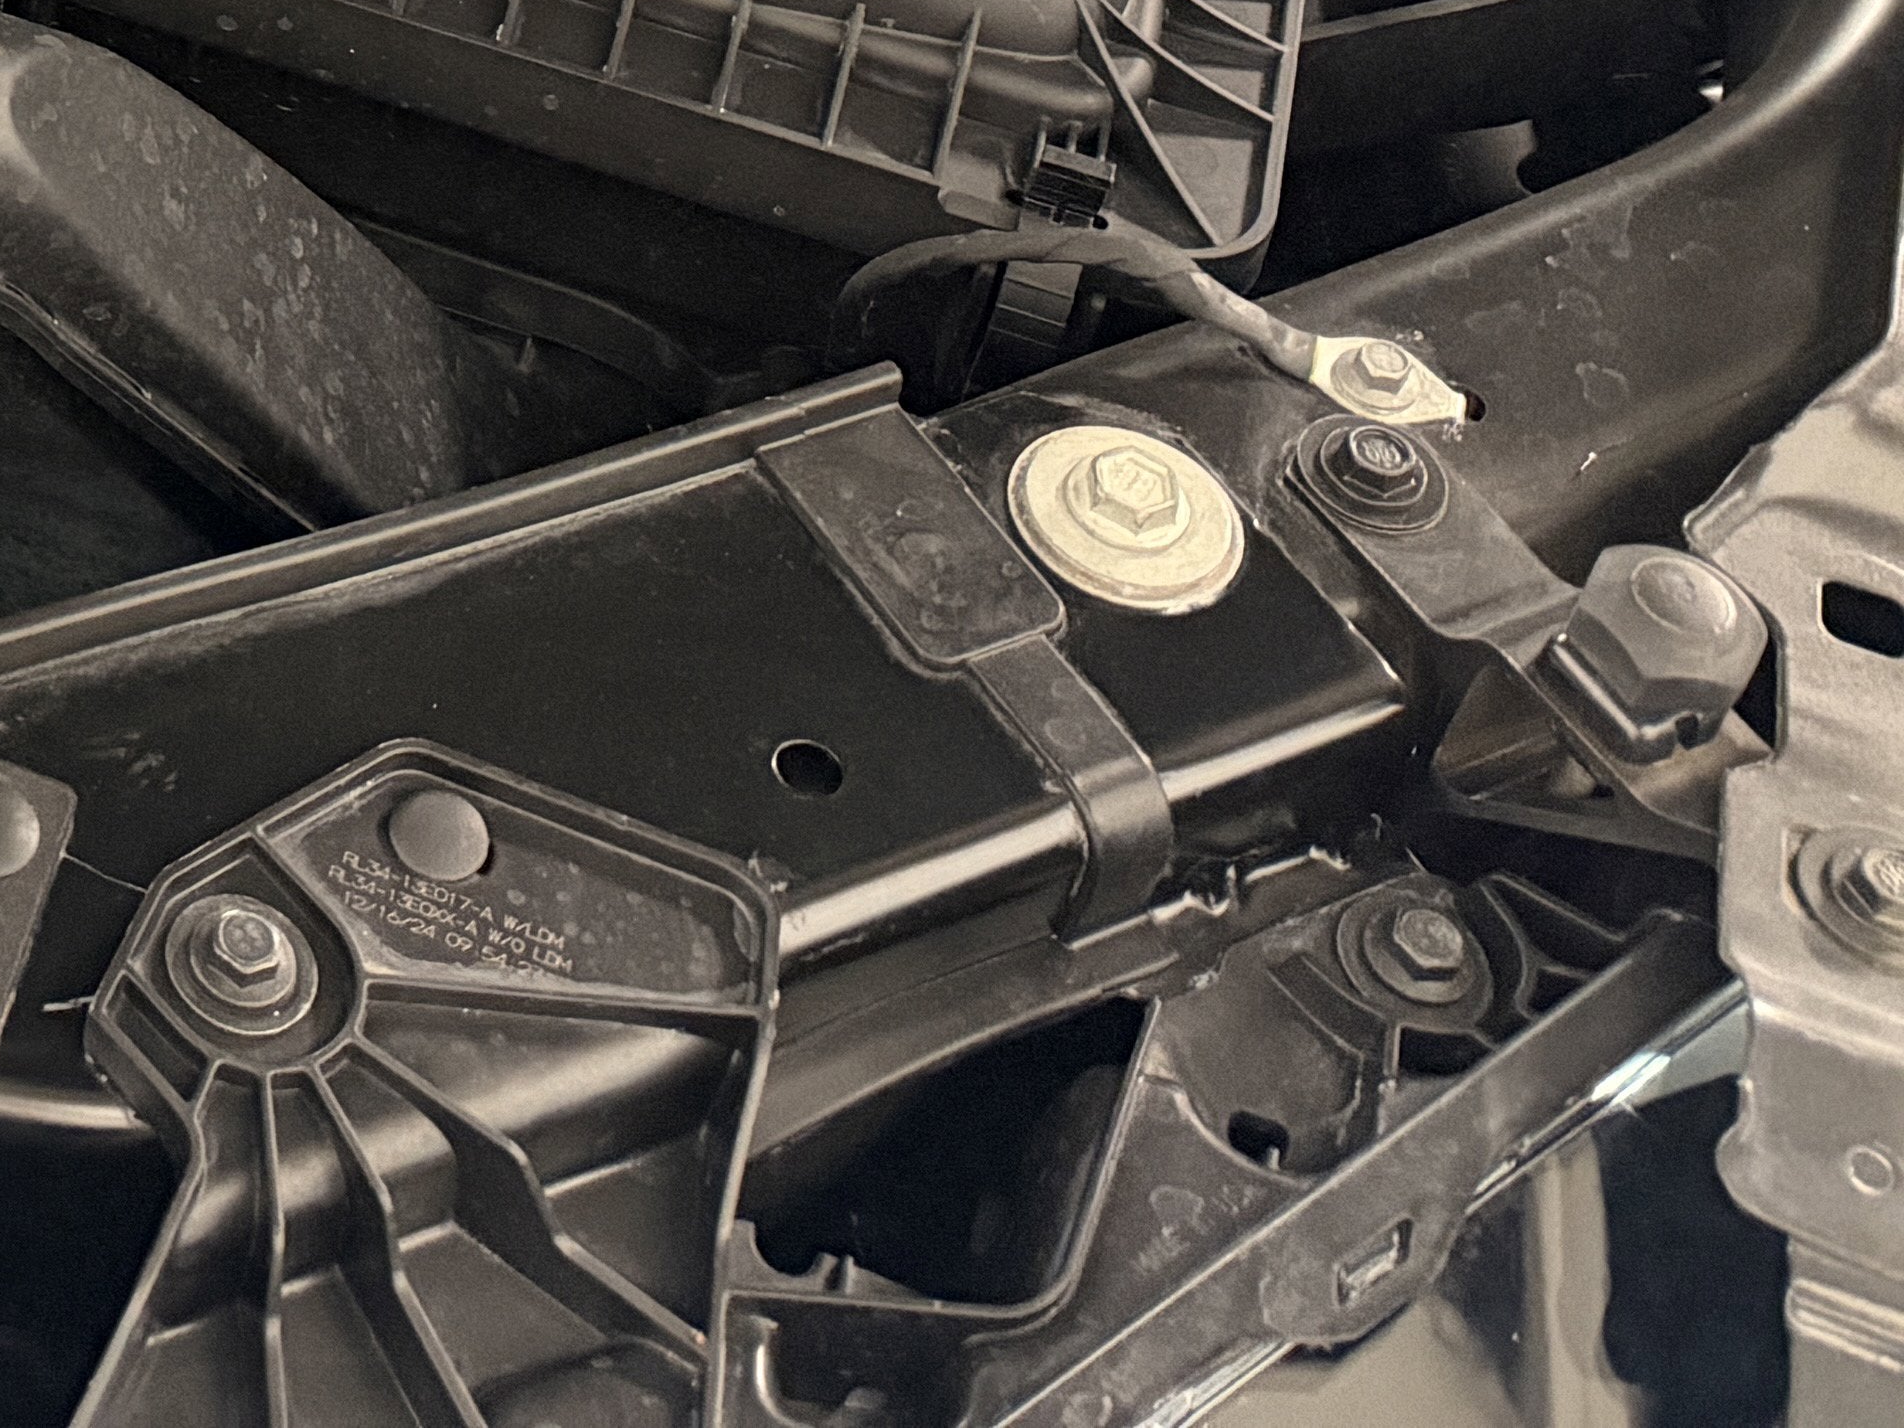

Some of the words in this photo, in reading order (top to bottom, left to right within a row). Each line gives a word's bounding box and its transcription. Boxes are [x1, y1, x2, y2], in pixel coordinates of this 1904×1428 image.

[488, 928, 525, 955] W/O
[532, 946, 573, 974] LDM
[503, 914, 565, 950] W/LDM
